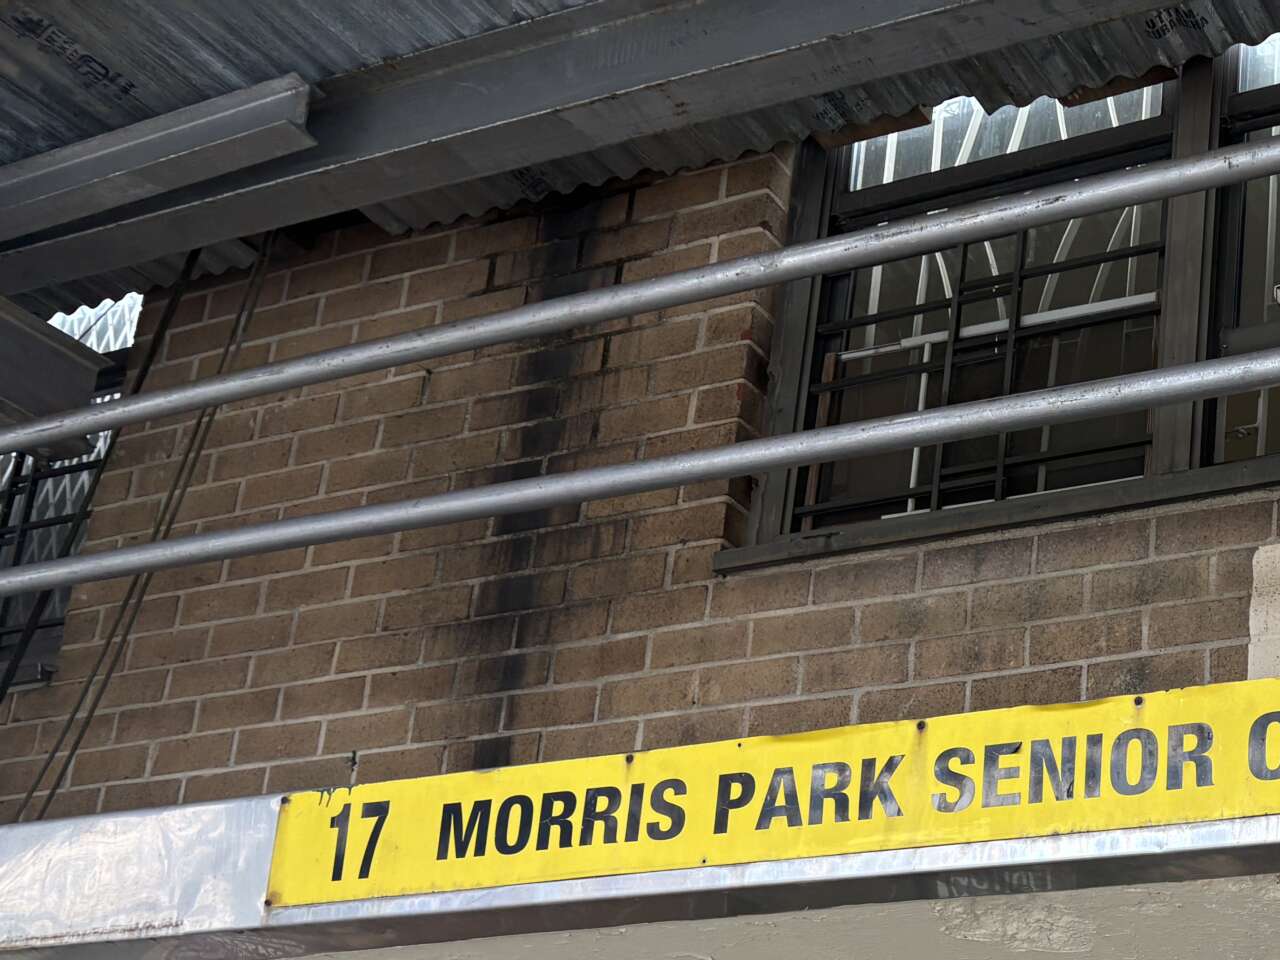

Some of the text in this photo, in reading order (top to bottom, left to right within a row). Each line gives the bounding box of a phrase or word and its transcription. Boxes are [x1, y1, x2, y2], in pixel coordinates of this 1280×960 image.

[330, 801, 390, 882] 17
[436, 778, 687, 861] MORRIS
[712, 755, 907, 835] PARK
[931, 721, 1213, 813] SENIOR
